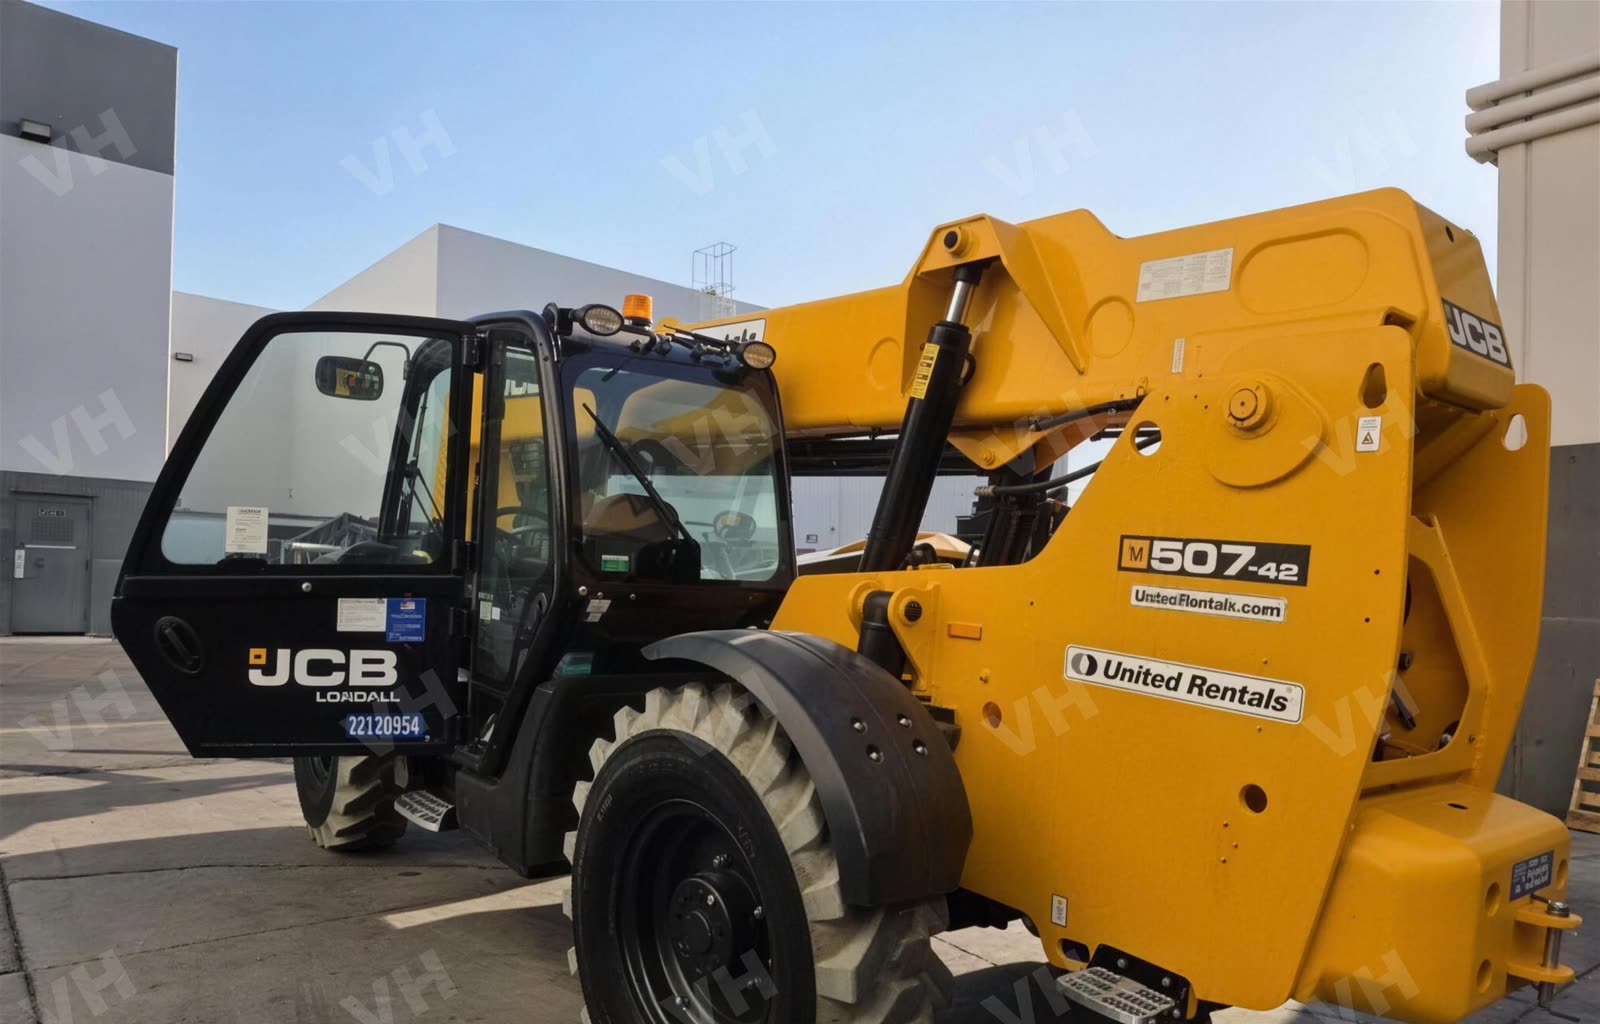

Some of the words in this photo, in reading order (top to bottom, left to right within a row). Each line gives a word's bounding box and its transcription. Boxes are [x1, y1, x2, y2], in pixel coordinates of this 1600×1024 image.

[1448, 306, 1508, 364] JCB
[1150, 539, 1299, 582] 507-42
[248, 648, 398, 687] JCB
[1103, 659, 1183, 692] United
[1186, 674, 1289, 713] Rentals
[349, 715, 420, 736] 22120954
